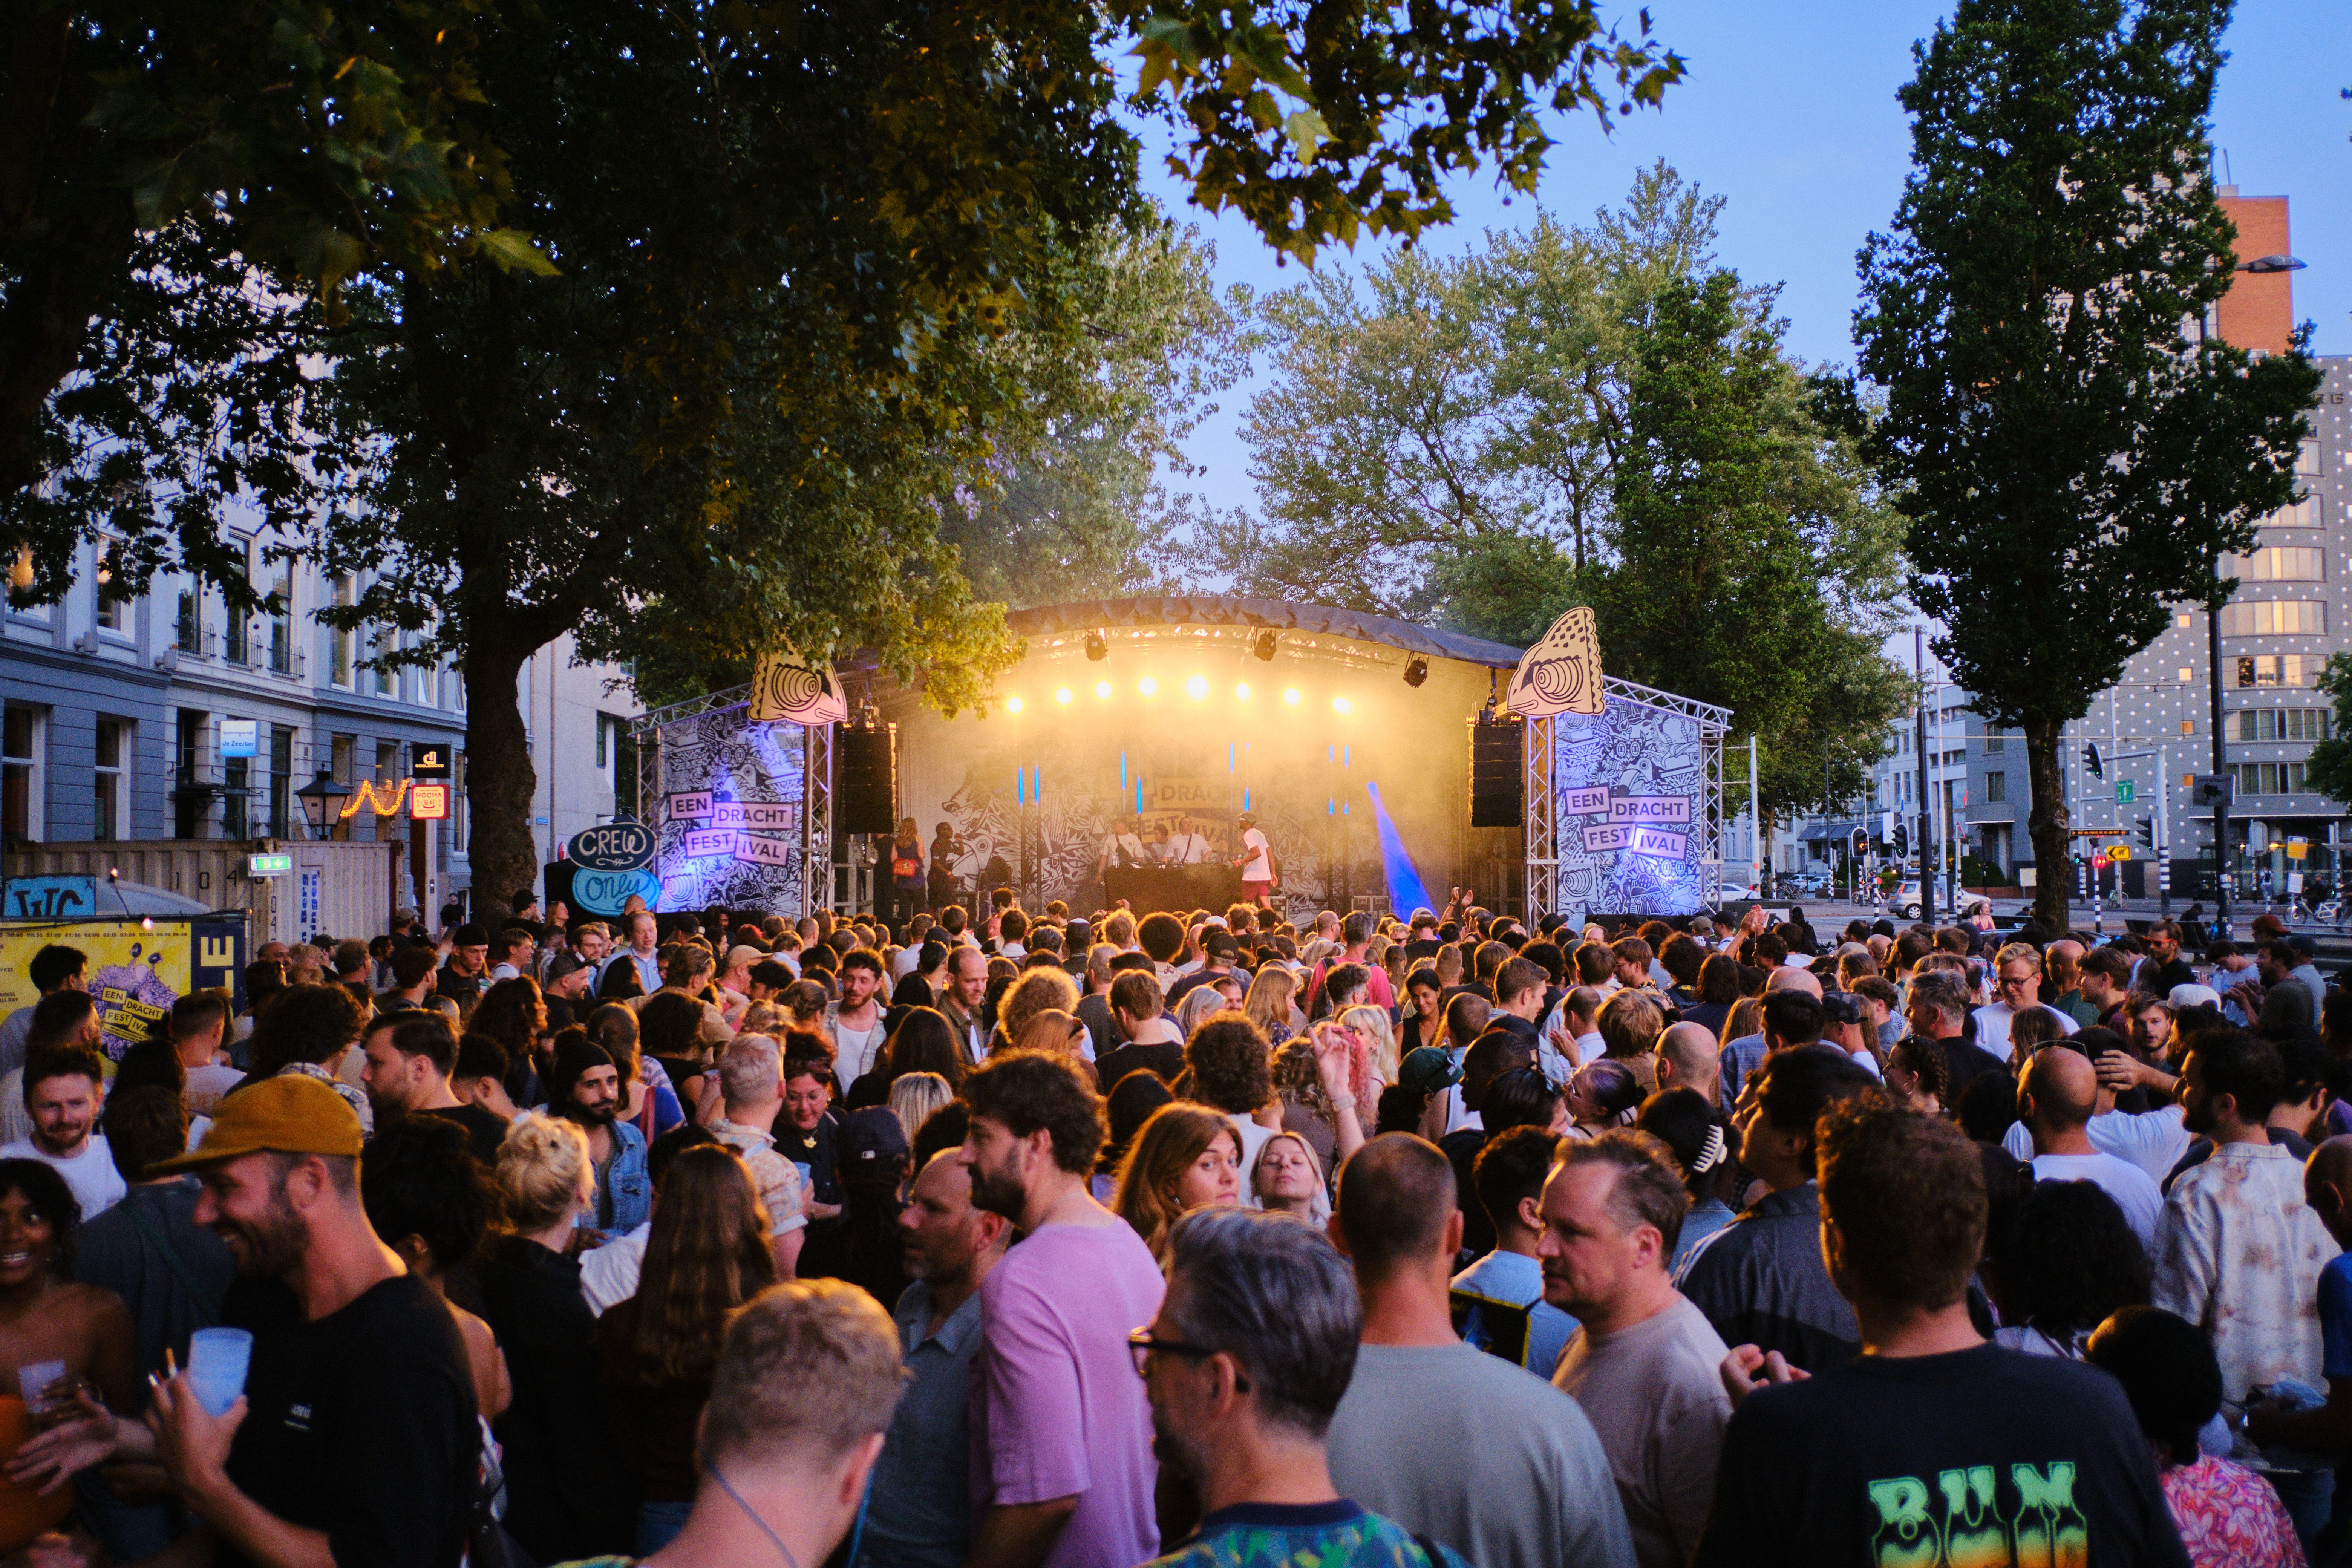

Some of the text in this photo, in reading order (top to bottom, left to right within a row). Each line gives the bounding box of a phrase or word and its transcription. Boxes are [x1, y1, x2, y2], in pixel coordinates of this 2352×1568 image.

[675, 798, 787, 822] EEN DRACHT
[1571, 793, 1684, 816] EEN DRACHT
[579, 828, 647, 856] CREW
[691, 833, 781, 859] FEST IVAL
[1589, 827, 1679, 852] FEST IVAL
[585, 874, 646, 909] Only
[105, 990, 161, 1018] EEN DRACHT
[108, 1012, 147, 1032] FEST IVA
